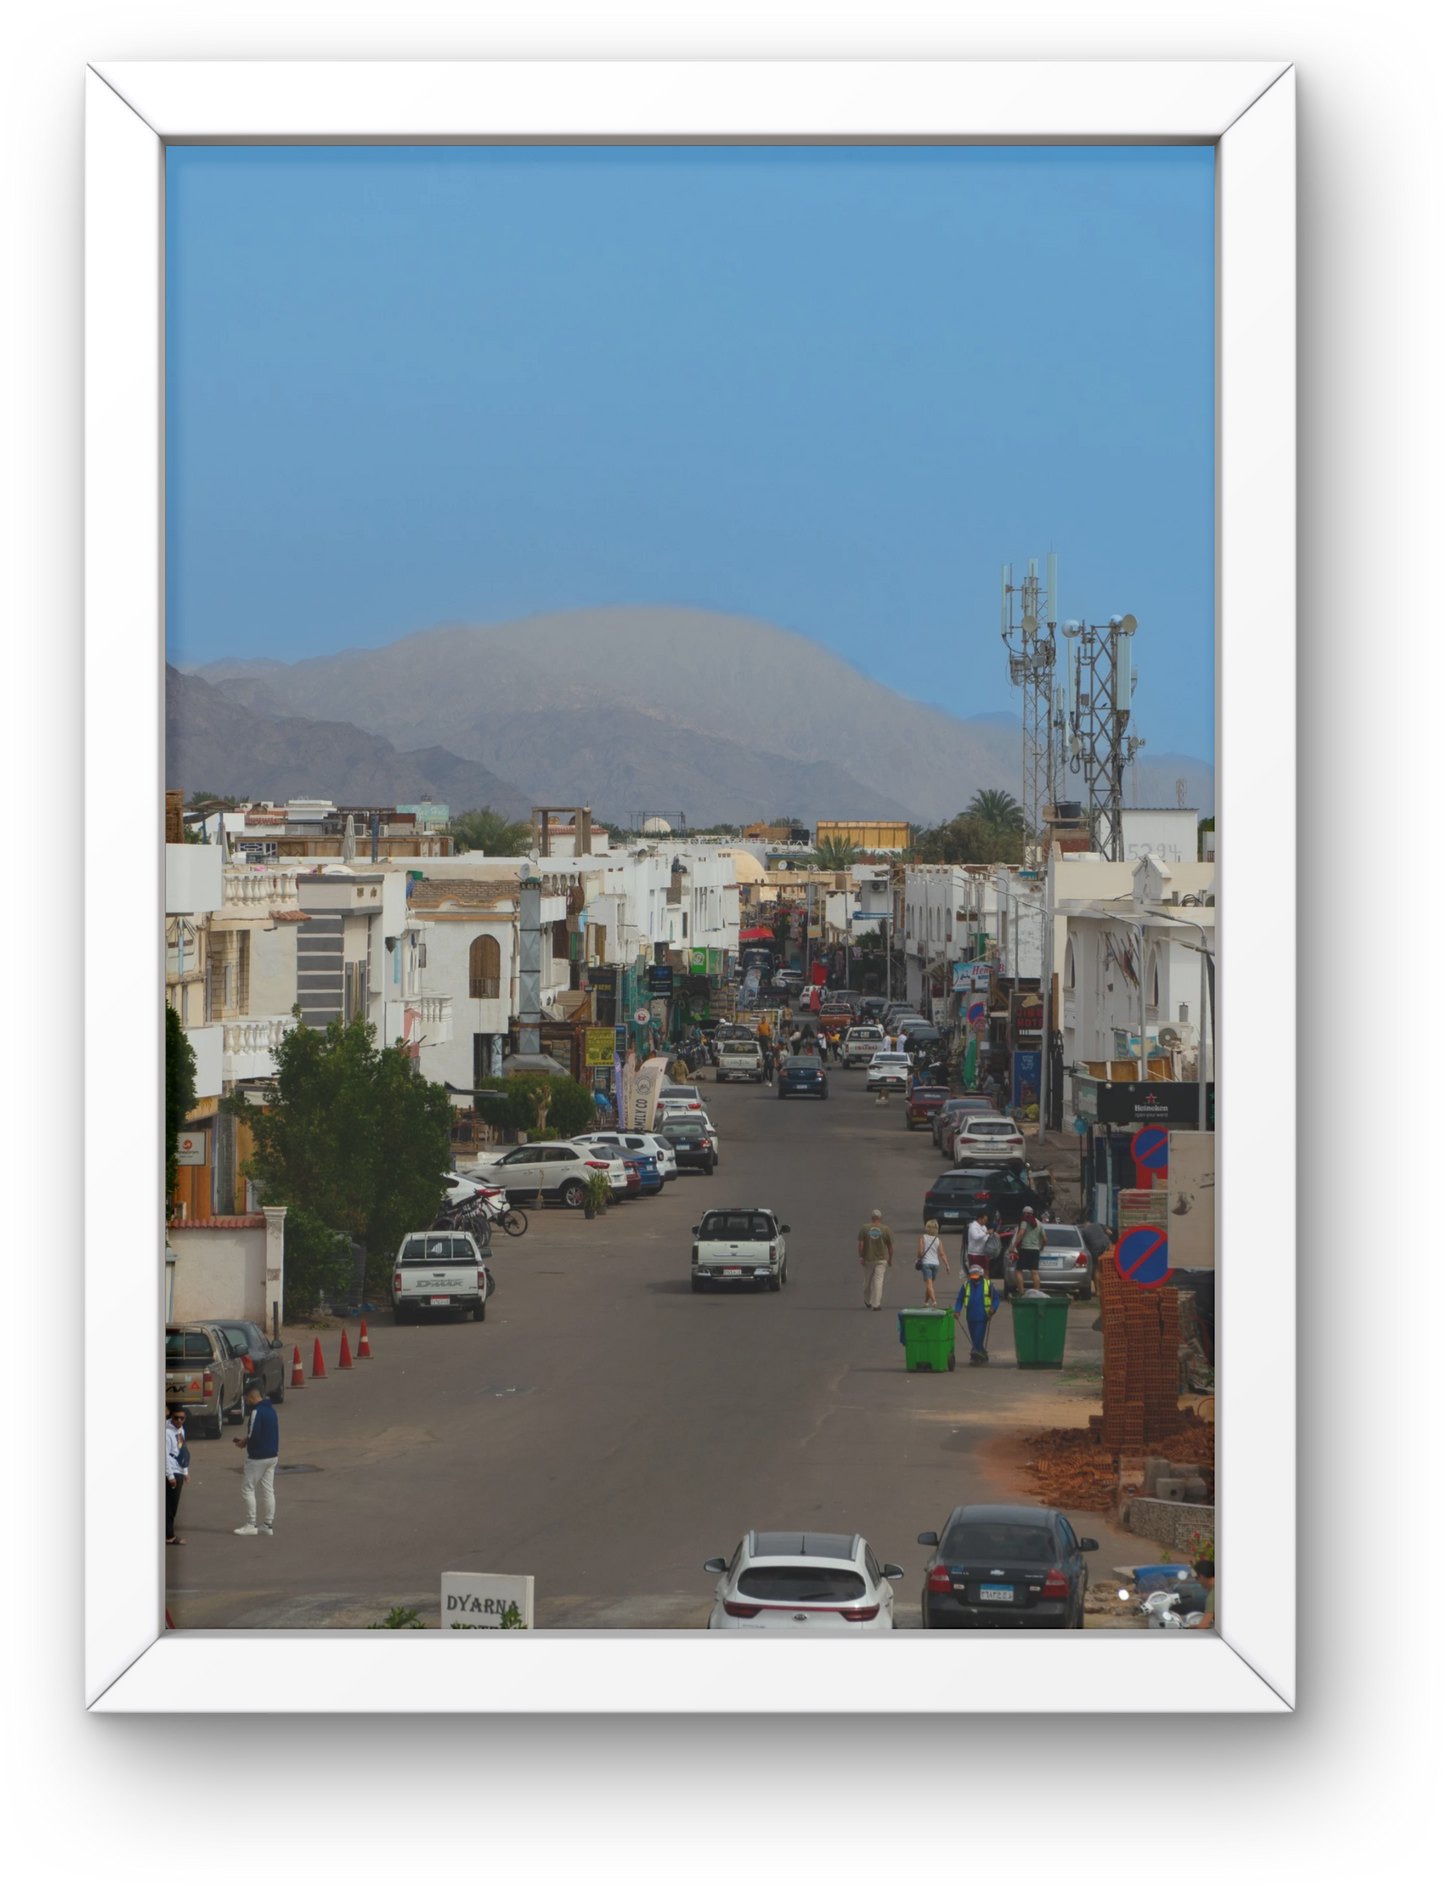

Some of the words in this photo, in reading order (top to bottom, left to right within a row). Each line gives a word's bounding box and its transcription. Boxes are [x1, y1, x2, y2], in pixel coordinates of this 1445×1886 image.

[1017, 1018, 1044, 1027] HOTE
[1134, 1104, 1169, 1112] Heineken
[447, 1594, 518, 1615] DYARNA
